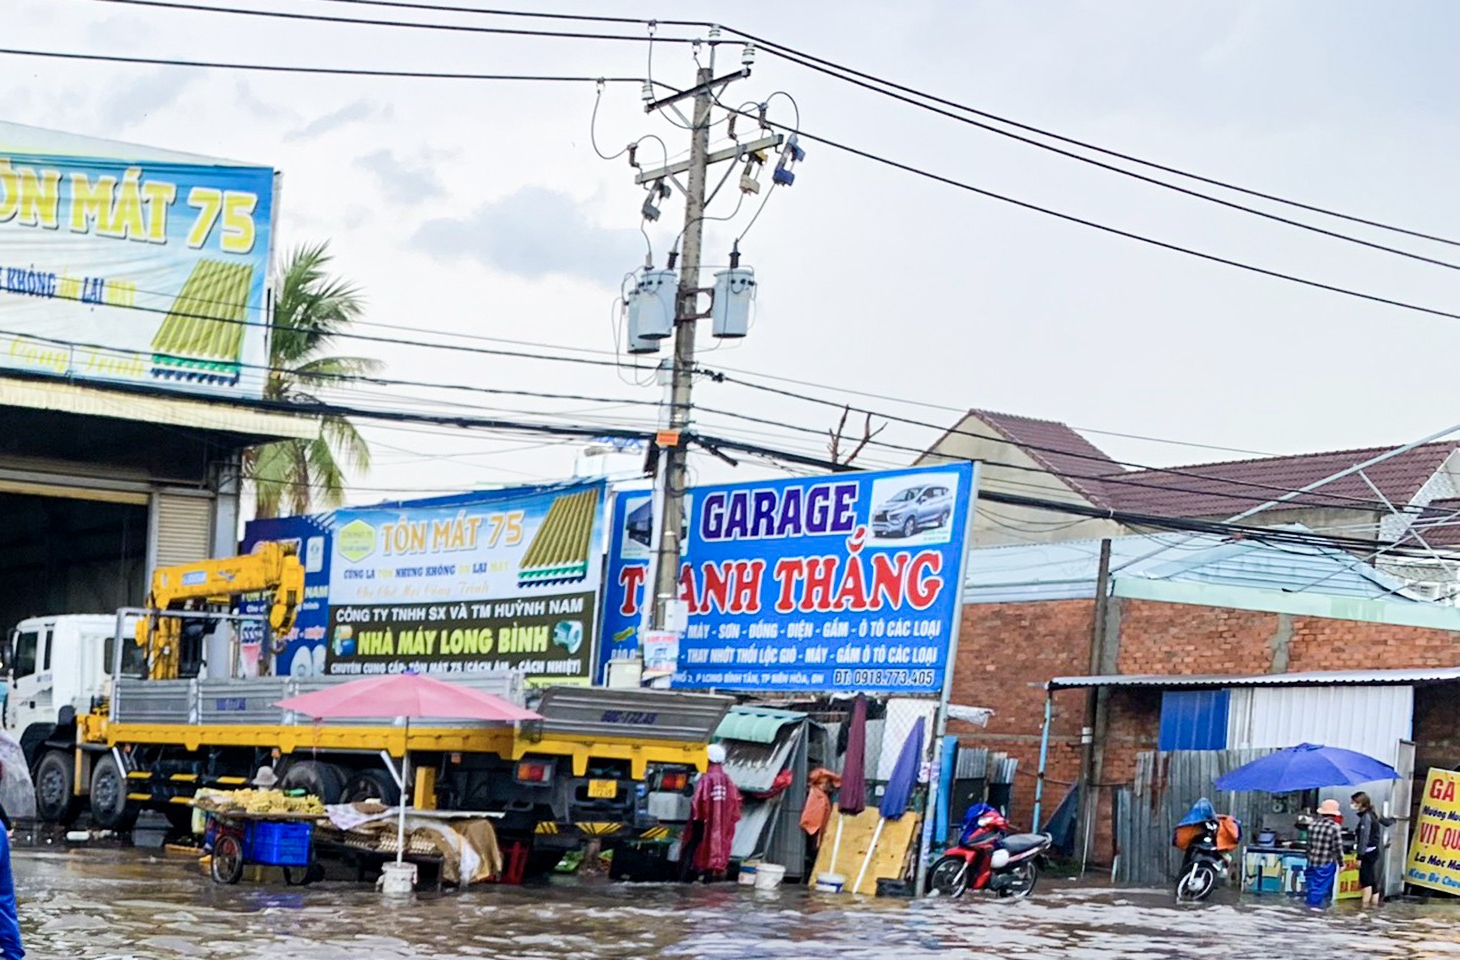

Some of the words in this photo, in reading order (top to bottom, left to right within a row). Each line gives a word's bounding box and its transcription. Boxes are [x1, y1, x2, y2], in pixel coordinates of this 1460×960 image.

[70, 166, 177, 245] MÁT
[186, 186, 258, 254] 75
[81, 276, 105, 312] LẠI
[701, 480, 861, 541] GARAGE
[382, 515, 427, 556] TÔN
[432, 510, 483, 554] MÁT
[487, 509, 526, 550] 75
[619, 560, 766, 616] TANH
[774, 526, 944, 614] THẮNG
[336, 606, 371, 622] CÔNG
[372, 608, 389, 622] TY
[391, 606, 426, 622] TNHH
[428, 605, 446, 620] SX
[449, 603, 468, 620] VÀ
[471, 604, 492, 619] TM
[494, 600, 546, 618] HUỲNH
[549, 597, 585, 615] NAM
[357, 626, 395, 655] NHÀ
[397, 625, 438, 655] MÁY
[439, 627, 494, 655] LONG
[497, 621, 550, 654] BÌNH
[718, 622, 740, 640] SƠN
[787, 618, 814, 642] ĐIỆN
[858, 618, 868, 638] Ô
[870, 618, 885, 638] TÔ
[886, 617, 912, 637] CÁC
[913, 618, 941, 640] LOẠI
[687, 647, 710, 664] THAY
[804, 643, 829, 664] MÁY
[862, 644, 872, 664] Ô
[873, 644, 887, 664] TÔ
[888, 643, 911, 663] CÁC
[912, 645, 939, 667] LOẠI
[853, 668, 935, 686] 0918.773.405
[1429, 775, 1456, 803] GÀ
[1419, 821, 1441, 850] VỊT
